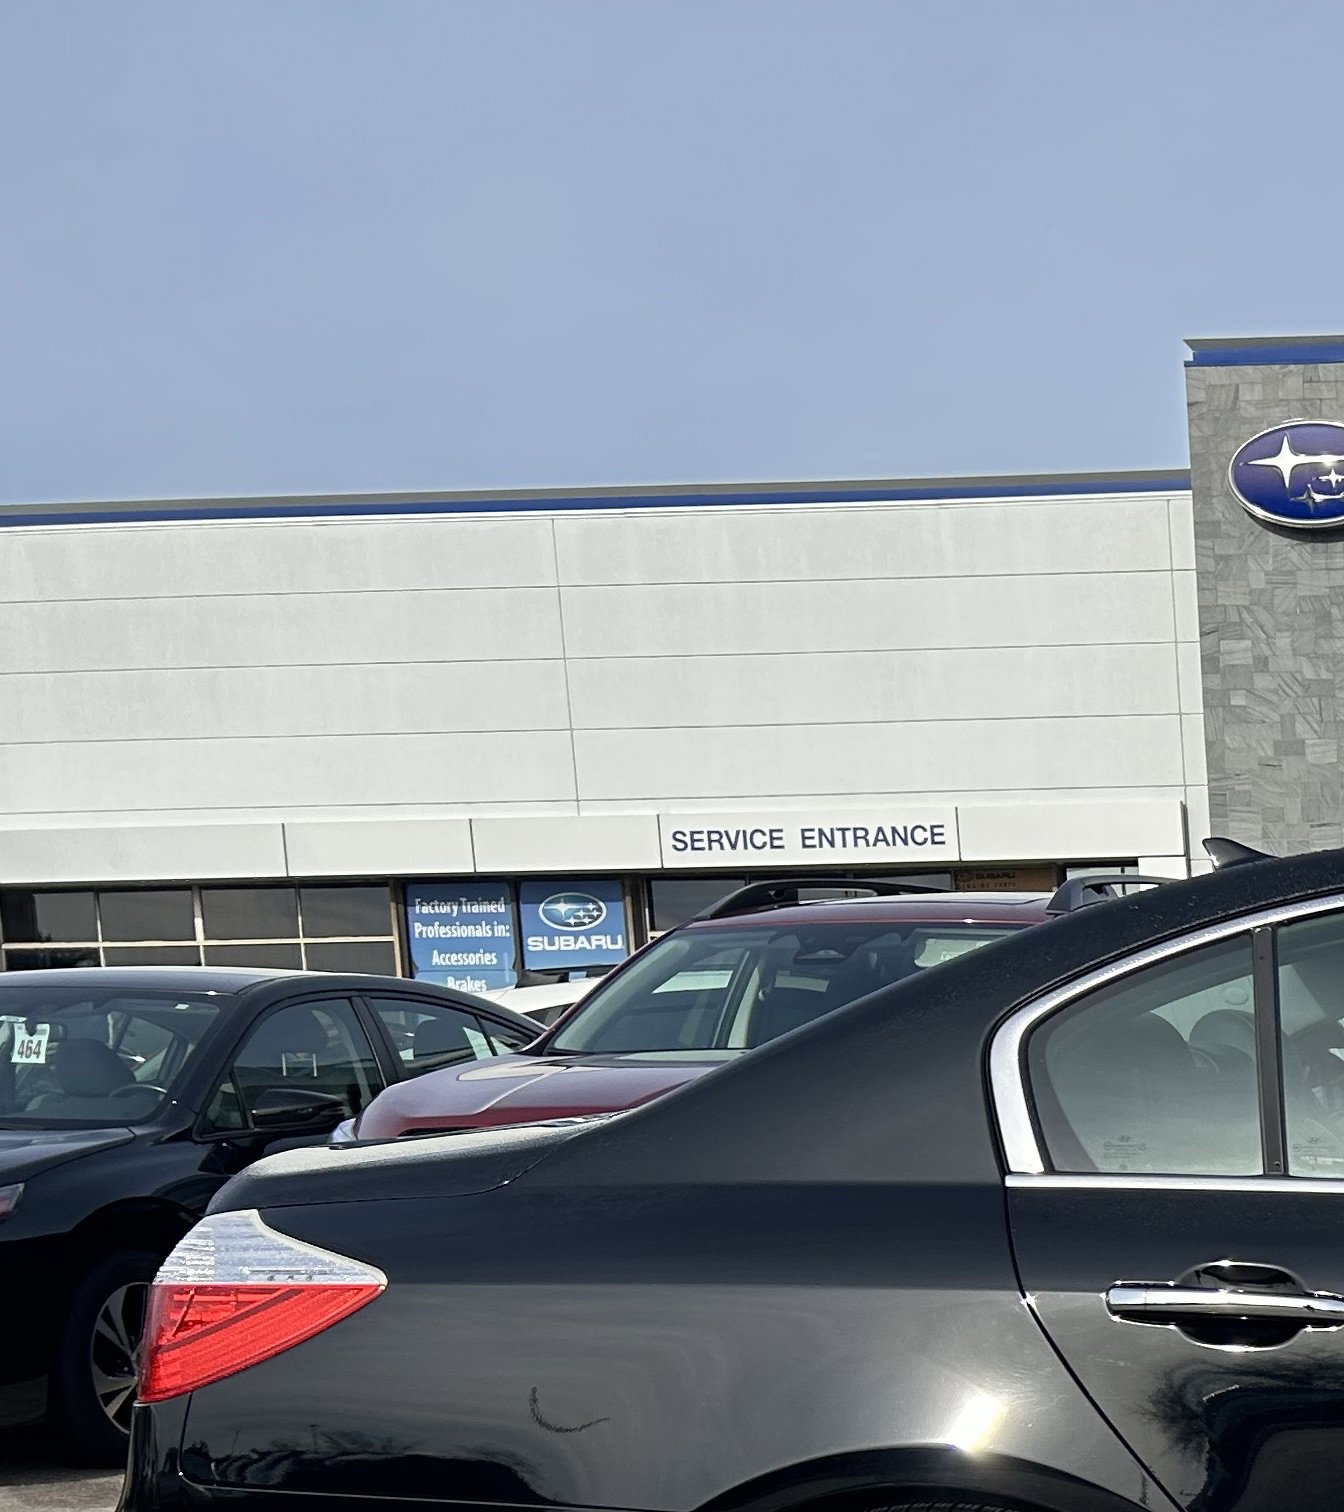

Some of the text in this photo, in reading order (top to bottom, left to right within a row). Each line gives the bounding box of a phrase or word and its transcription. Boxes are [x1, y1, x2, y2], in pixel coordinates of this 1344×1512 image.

[671, 824, 946, 852] SERVICE ENTRANCE
[415, 897, 505, 916] Factory Trained
[414, 921, 510, 938] Professionals in:
[527, 934, 623, 951] SUBARU
[432, 949, 498, 966] Accessories
[447, 976, 487, 992] Brakes
[17, 1039, 43, 1059] 464
